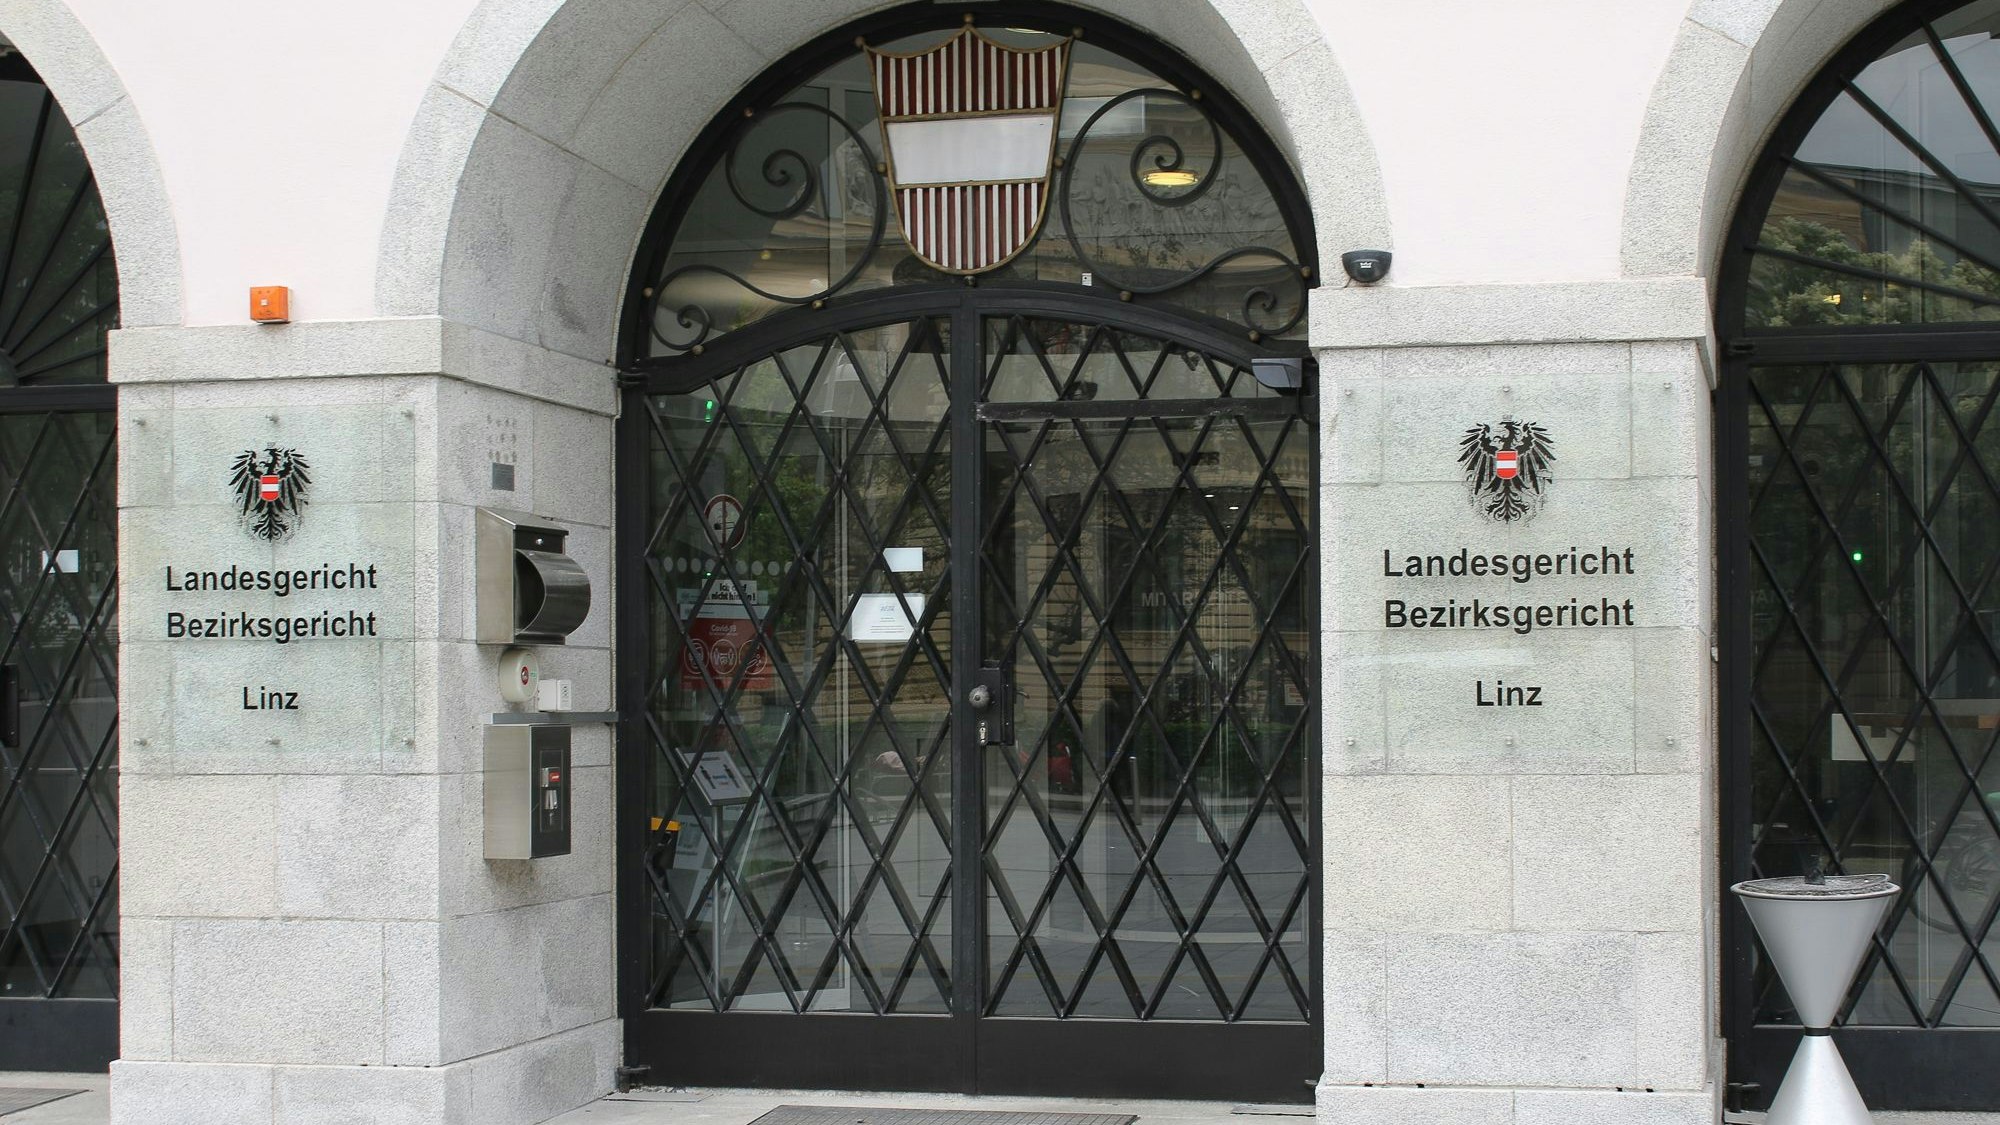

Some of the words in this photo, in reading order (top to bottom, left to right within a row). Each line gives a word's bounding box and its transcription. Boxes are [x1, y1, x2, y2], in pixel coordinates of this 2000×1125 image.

[167, 563, 377, 598] Landesgericht
[1384, 546, 1635, 584] Landesgericht
[168, 611, 377, 646] Bezirksgericht
[1386, 597, 1635, 636] Bezirksgericht
[243, 686, 299, 710] Linz
[1476, 679, 1543, 707] Linz
